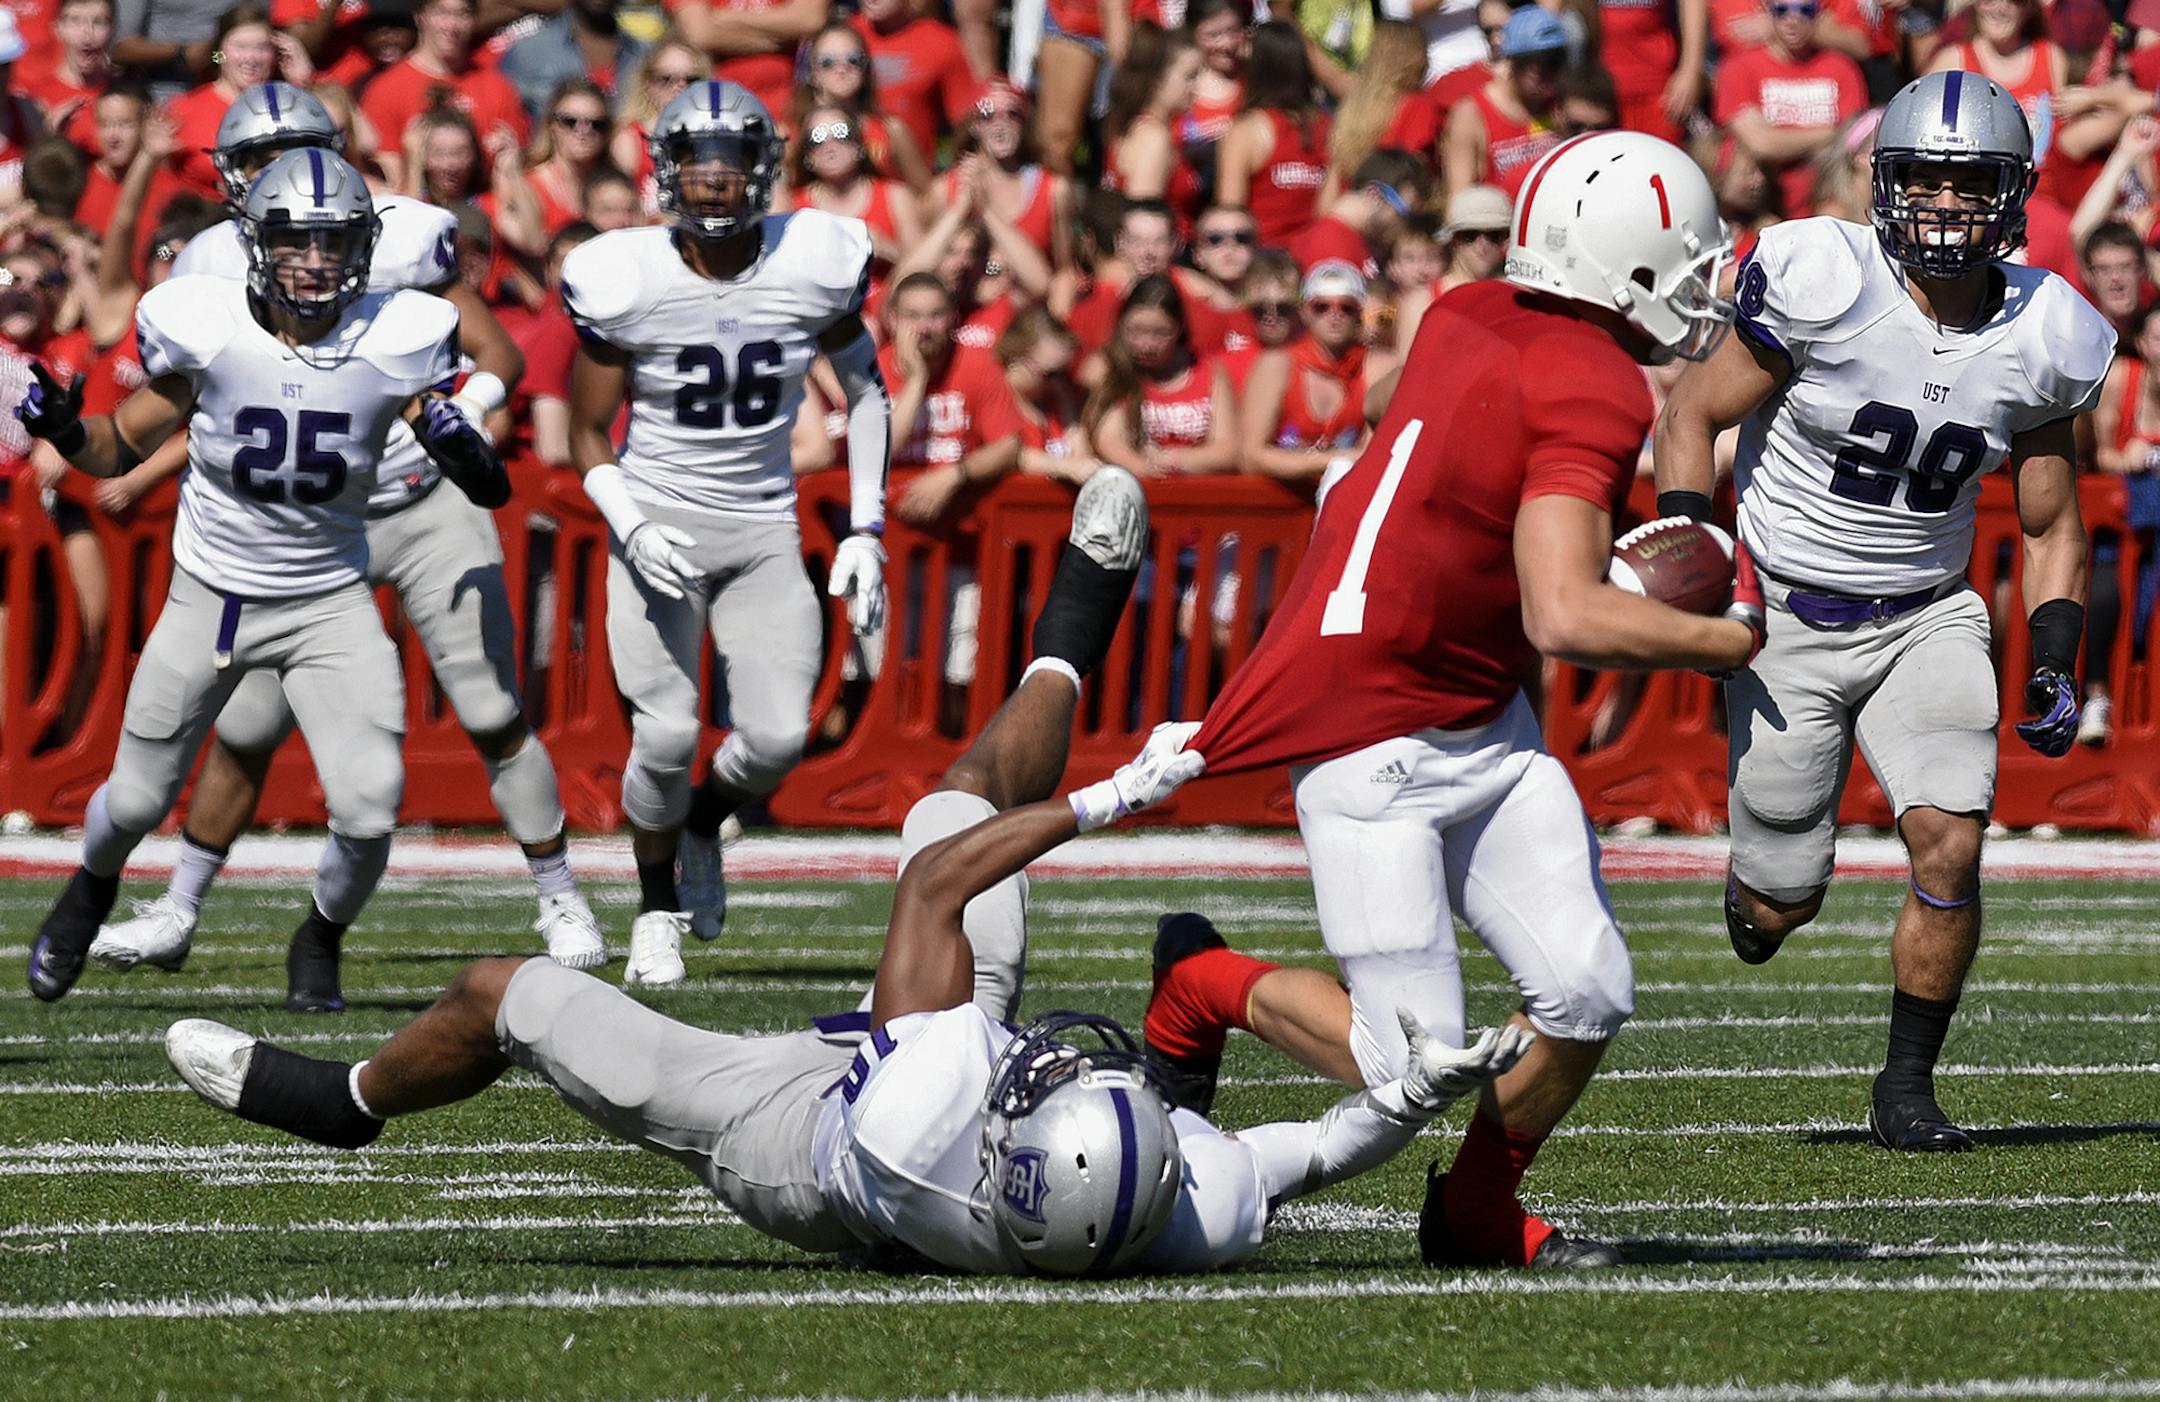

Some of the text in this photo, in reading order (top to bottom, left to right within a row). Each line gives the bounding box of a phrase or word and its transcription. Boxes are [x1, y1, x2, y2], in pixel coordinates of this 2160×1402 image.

[1649, 174, 1671, 230] 1
[281, 382, 304, 399] UST
[676, 340, 784, 430] 26
[1922, 381, 1951, 405] UST
[231, 405, 352, 505] 25
[1828, 400, 1989, 513] 28
[1320, 418, 1425, 637] 1
